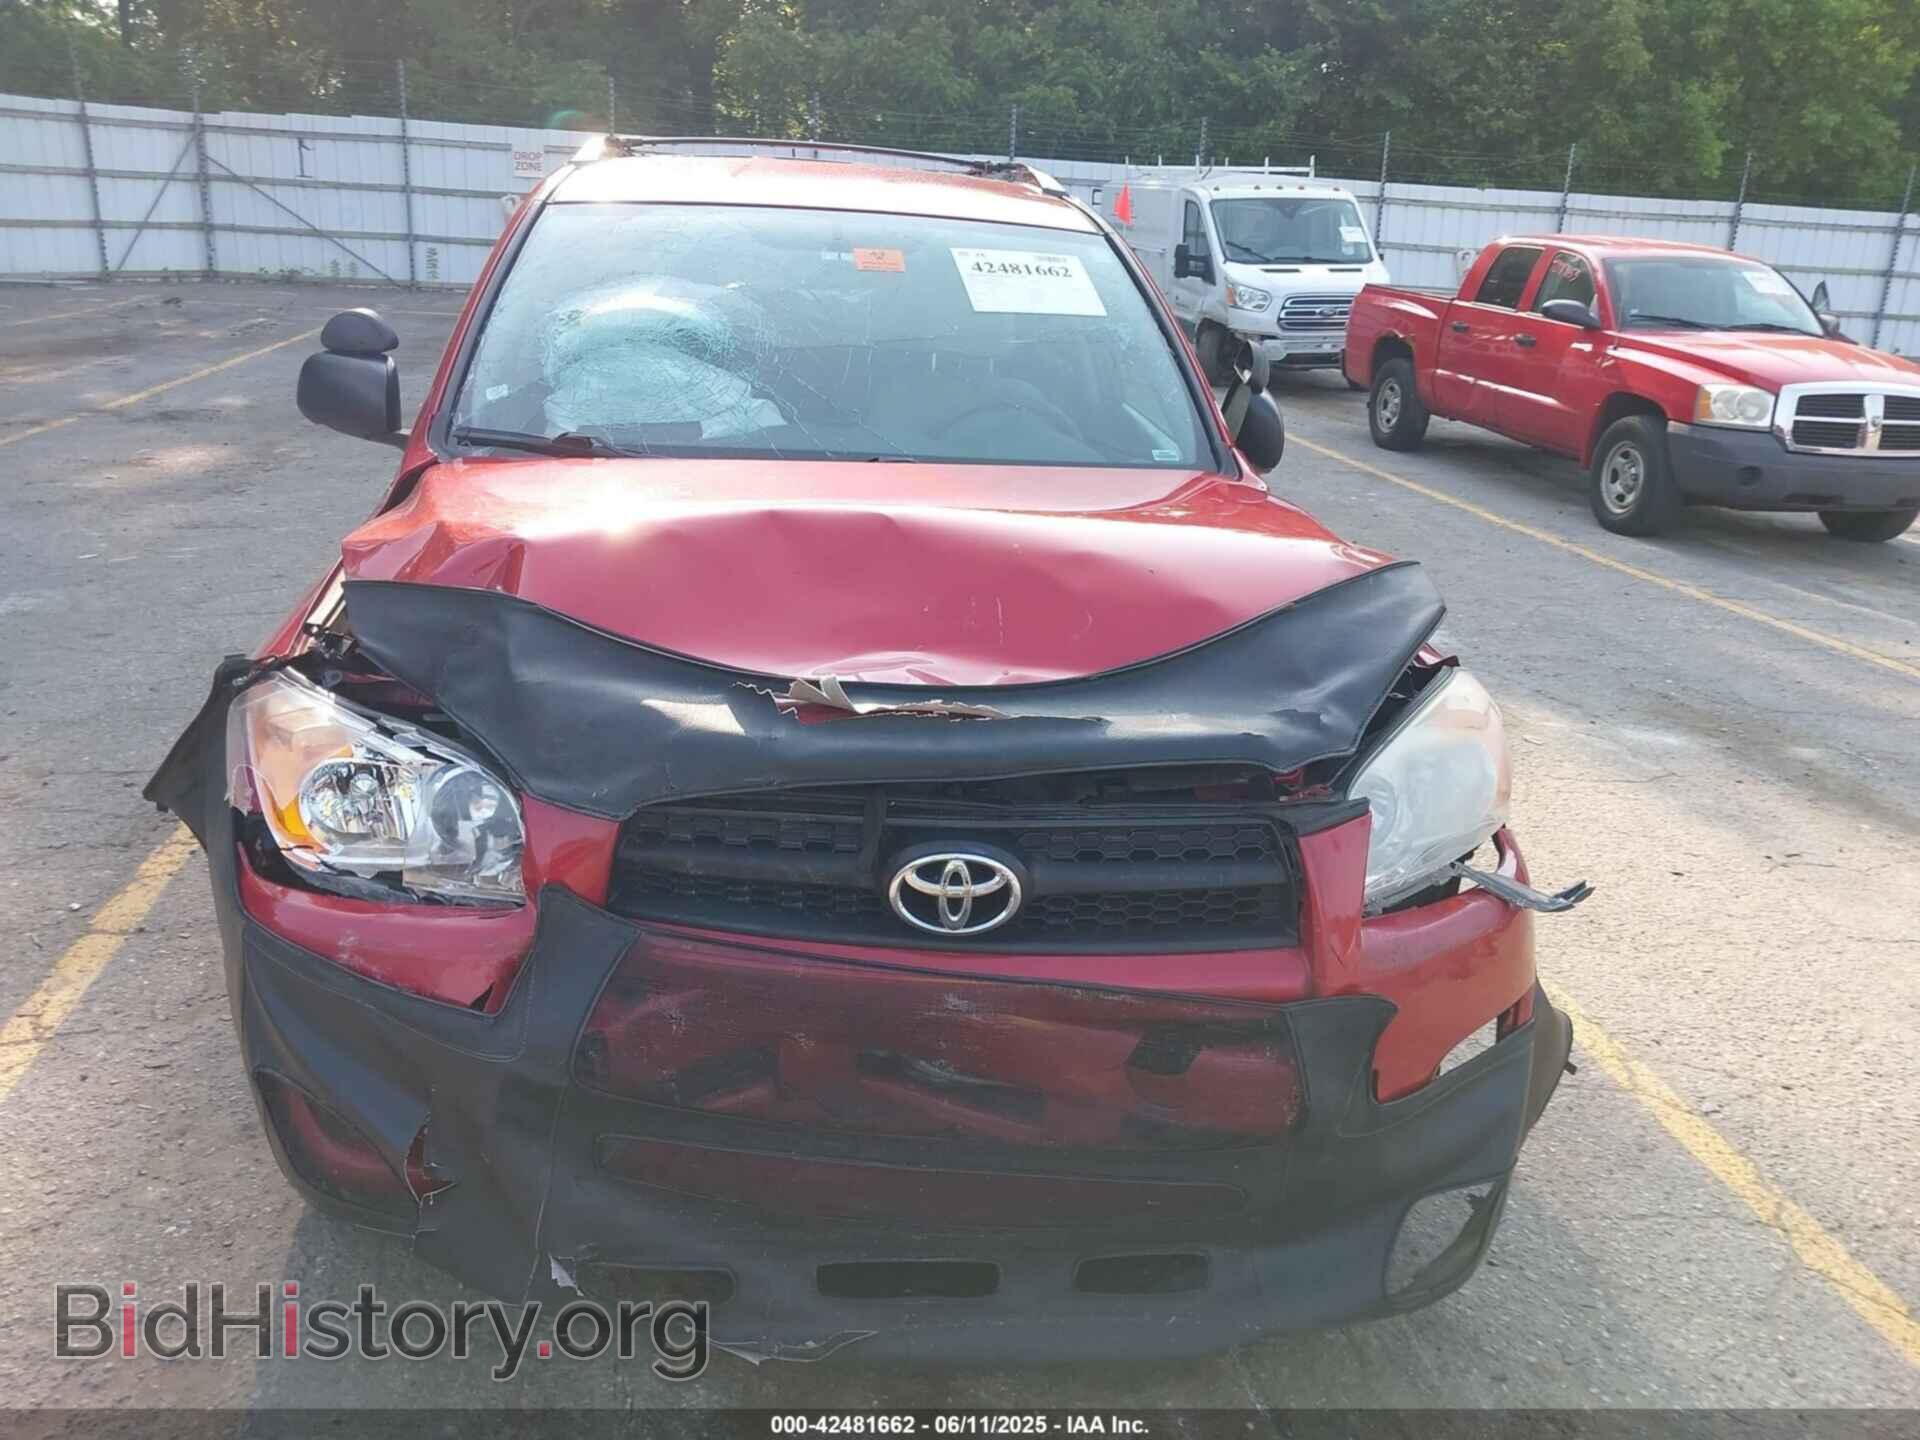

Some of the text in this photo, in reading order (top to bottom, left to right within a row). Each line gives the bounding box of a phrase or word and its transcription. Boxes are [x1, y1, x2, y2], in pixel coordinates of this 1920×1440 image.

[513, 151, 543, 161] DROP
[515, 161, 542, 172] ZONE
[971, 261, 1073, 278] 42481662
